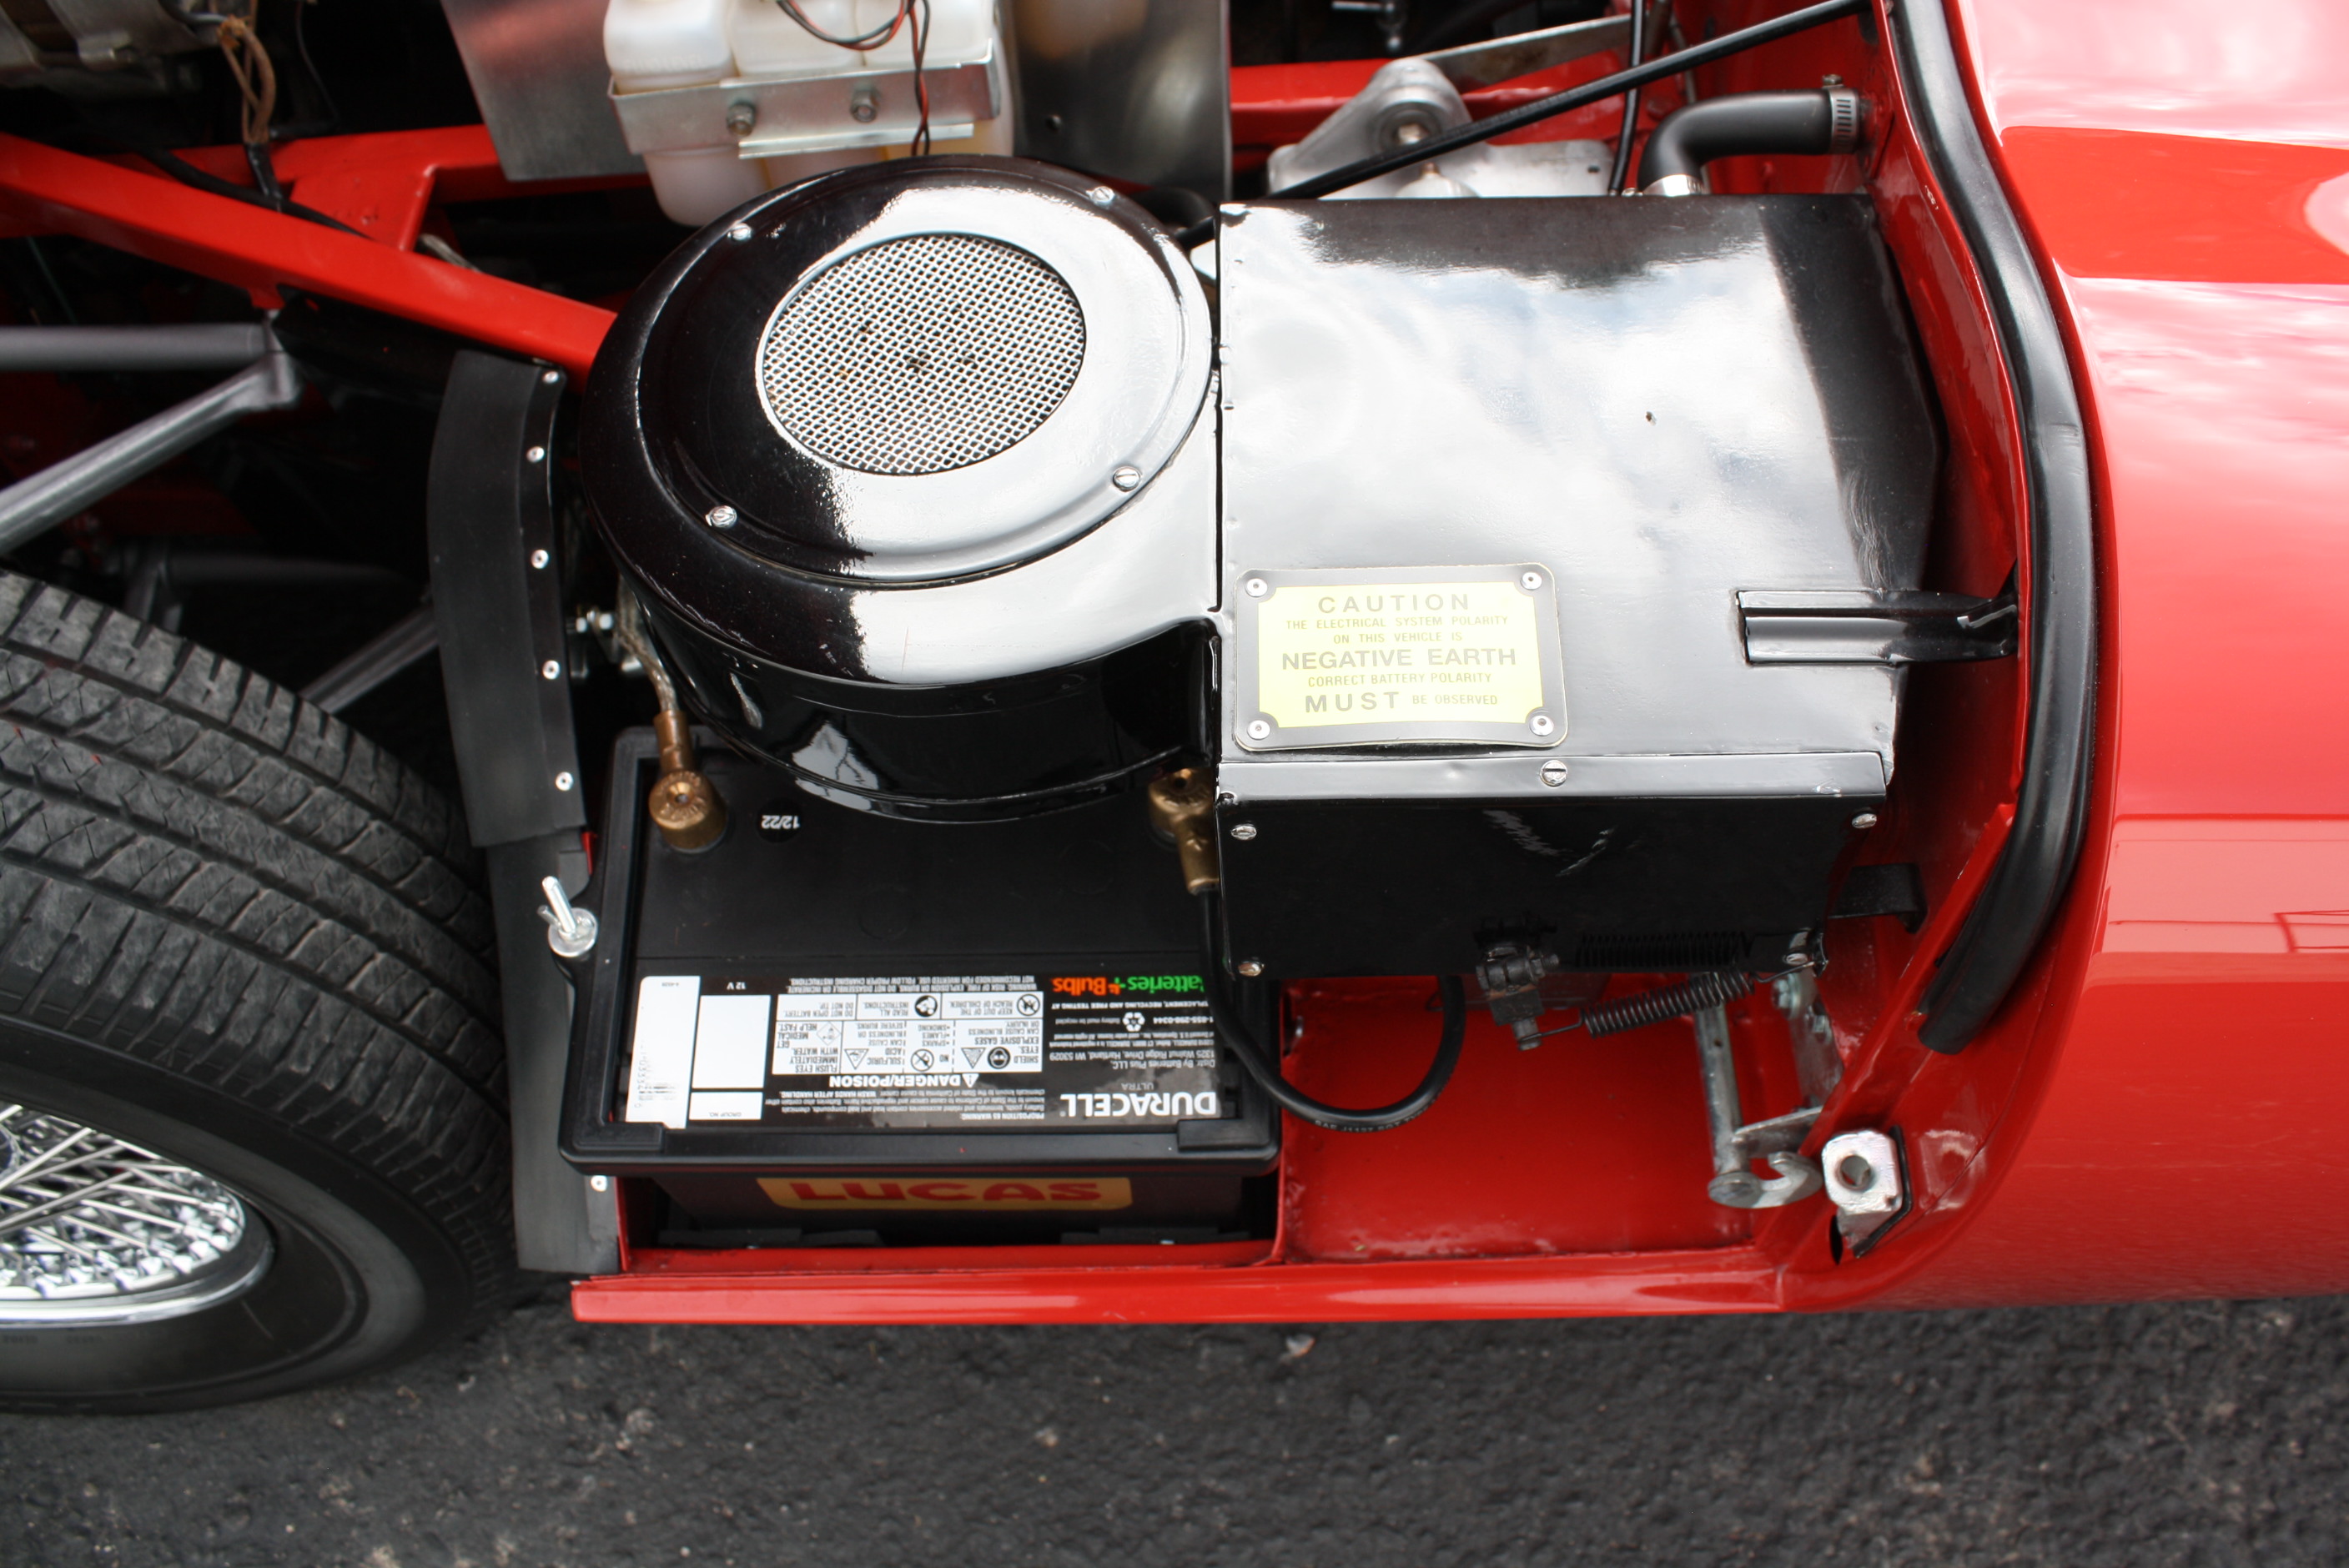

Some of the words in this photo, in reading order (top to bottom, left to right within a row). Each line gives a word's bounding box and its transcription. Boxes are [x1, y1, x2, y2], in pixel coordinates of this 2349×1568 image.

[1318, 594, 1468, 614] CAUTION
[1286, 621, 1307, 630] THE
[1316, 618, 1386, 629] ELECTRICAL
[1395, 617, 1442, 627] SYSTEM
[1451, 616, 1507, 626] POLARITY
[1334, 635, 1349, 645] ON
[1359, 633, 1385, 643] THIS
[1394, 632, 1441, 642] VEHICLE
[1451, 632, 1462, 641] IS
[1282, 649, 1412, 670] NEGATIVE
[1427, 648, 1516, 666] EARTH
[1308, 674, 1366, 687] CORRECT
[1371, 673, 1425, 684] BATTERY
[1431, 672, 1491, 683] POLARITY
[1305, 691, 1399, 713] MUST
[1412, 695, 1428, 705] BE
[1435, 694, 1498, 705] OBSERVED
[727, 982, 734, 990] V
[974, 1037, 998, 1045] GASES
[939, 1054, 948, 1063] NO
[1014, 1055, 1039, 1063] SHIELD
[1074, 1052, 1086, 1061] WI
[1144, 1049, 1167, 1059] Ridge
[866, 1057, 902, 1065] SULFURIC
[1129, 1060, 1146, 1068] Plus
[1148, 1059, 1182, 1068] Batteries
[1184, 1058, 1194, 1068] By
[829, 1074, 961, 1087] DANGER/POISON
[1121, 1082, 1154, 1091] ULTRA
[1060, 1092, 1216, 1117] DURACELL
[789, 1182, 1102, 1202] LUCAS
